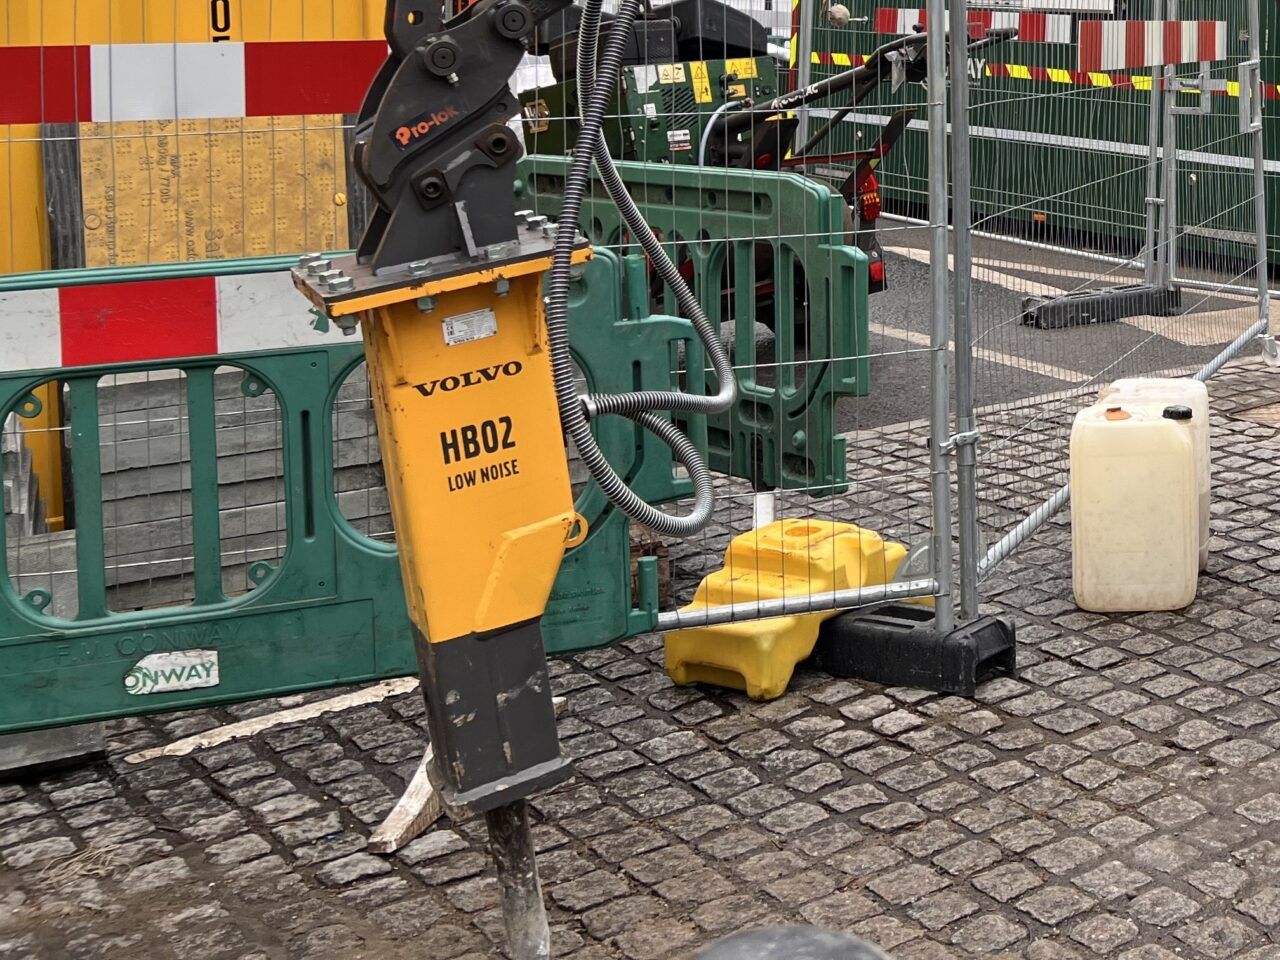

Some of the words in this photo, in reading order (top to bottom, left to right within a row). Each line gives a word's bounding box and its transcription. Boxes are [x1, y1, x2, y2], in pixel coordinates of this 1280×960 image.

[412, 360, 523, 397] VOLVO
[440, 415, 516, 465] HB02
[447, 470, 477, 492] LOW
[480, 459, 519, 483] NOISE
[116, 621, 242, 656] CONWAY
